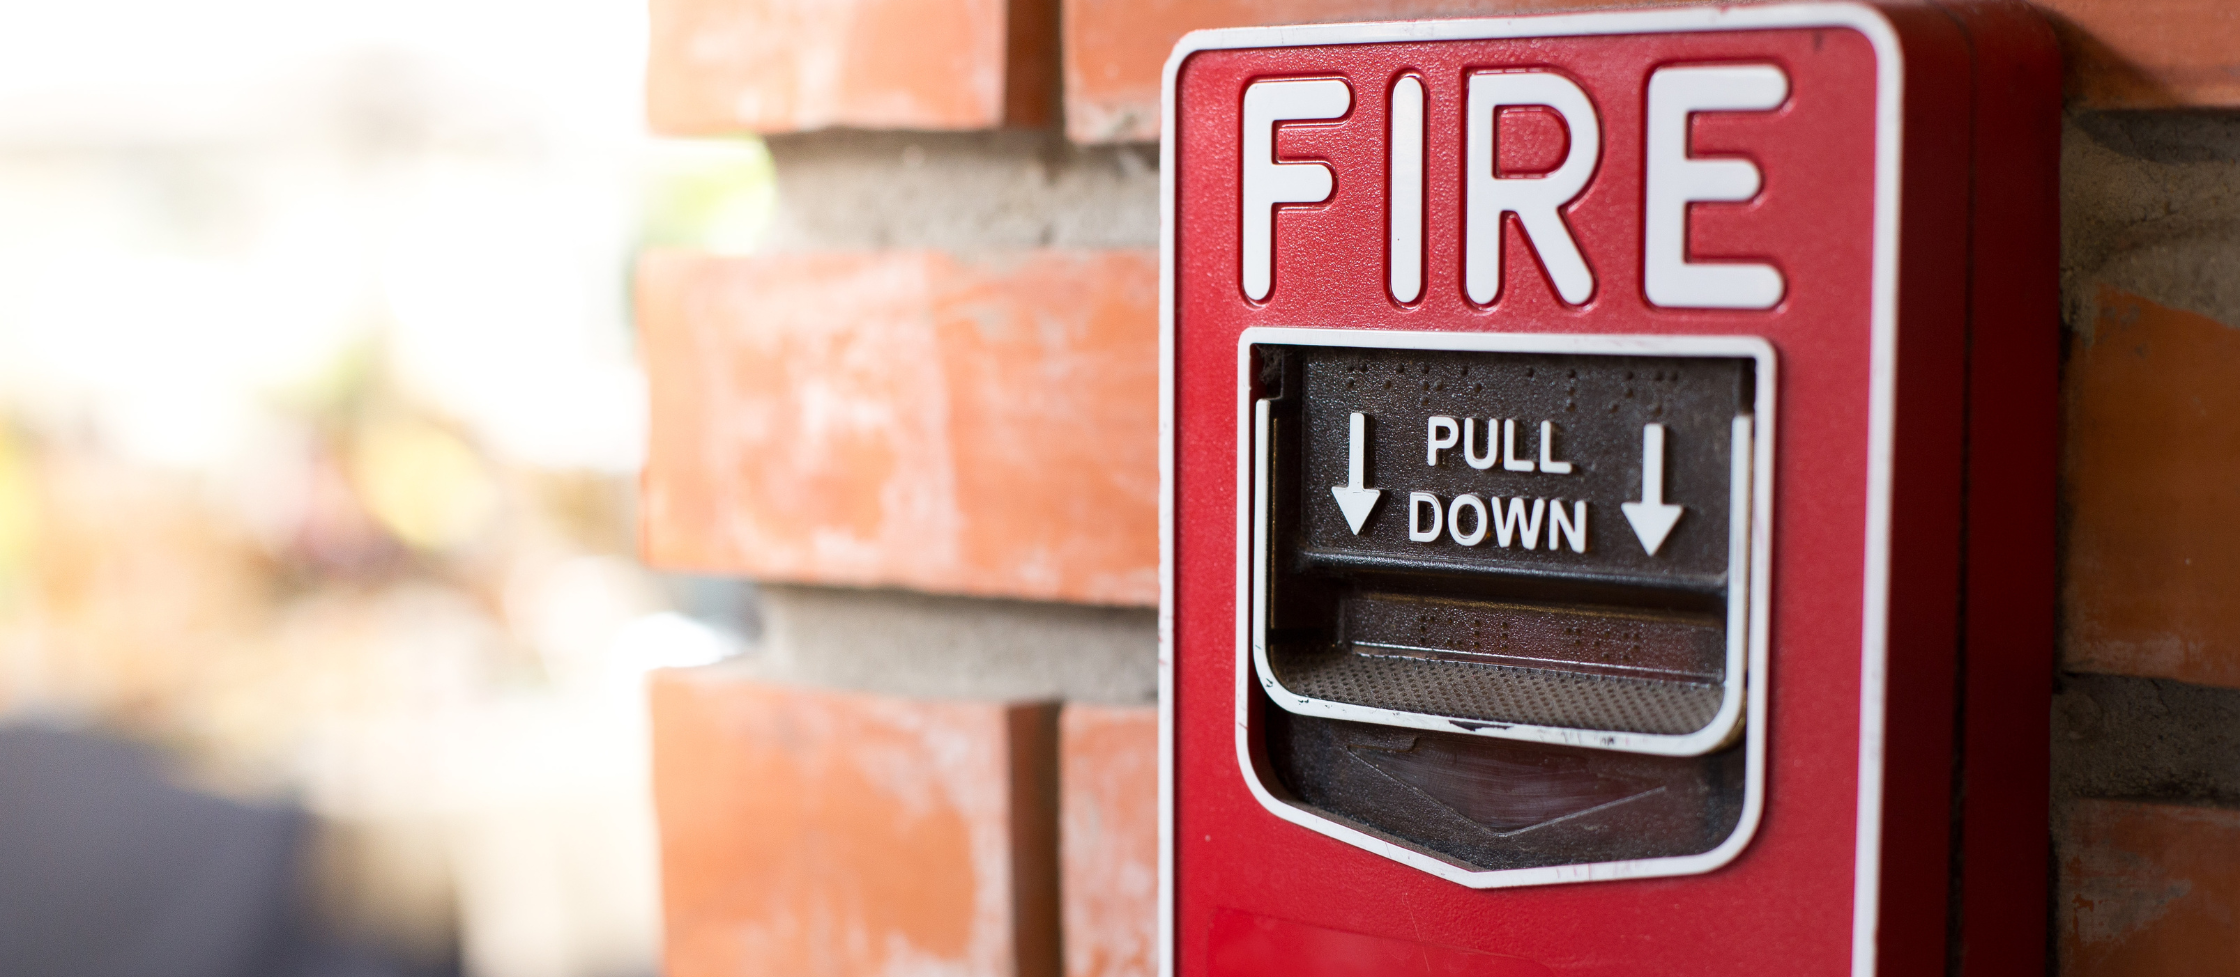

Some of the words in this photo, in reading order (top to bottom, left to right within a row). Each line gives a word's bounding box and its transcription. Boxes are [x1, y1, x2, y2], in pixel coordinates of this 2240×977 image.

[1243, 66, 1785, 307] FIRE
[1427, 415, 1571, 473] PULL
[1408, 490, 1586, 553] DOWN
